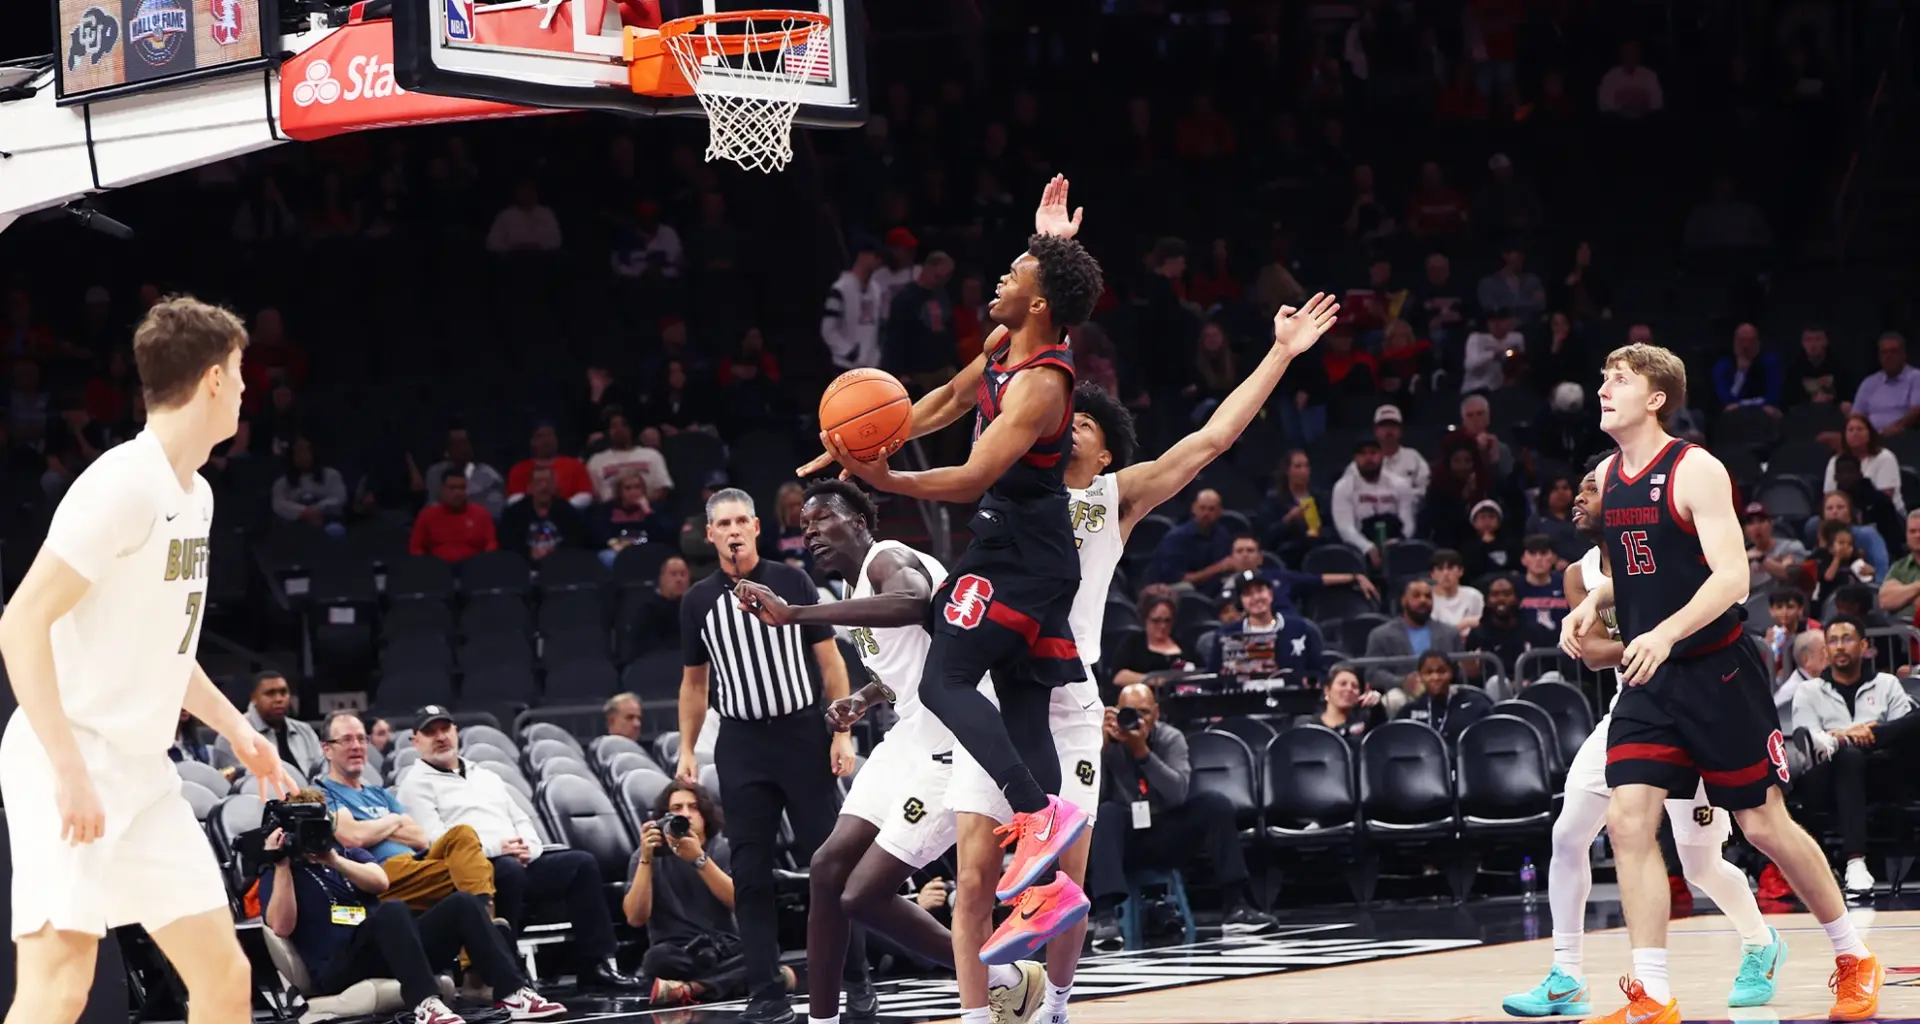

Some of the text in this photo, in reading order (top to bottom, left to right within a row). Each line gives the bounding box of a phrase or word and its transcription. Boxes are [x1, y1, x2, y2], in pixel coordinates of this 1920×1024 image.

[161, 11, 184, 29] FAME
[451, 19, 465, 35] NBA
[343, 55, 406, 101] Sta
[1605, 507, 1658, 528] STANFORD
[1621, 531, 1656, 575] 15
[178, 591, 203, 654] 7
